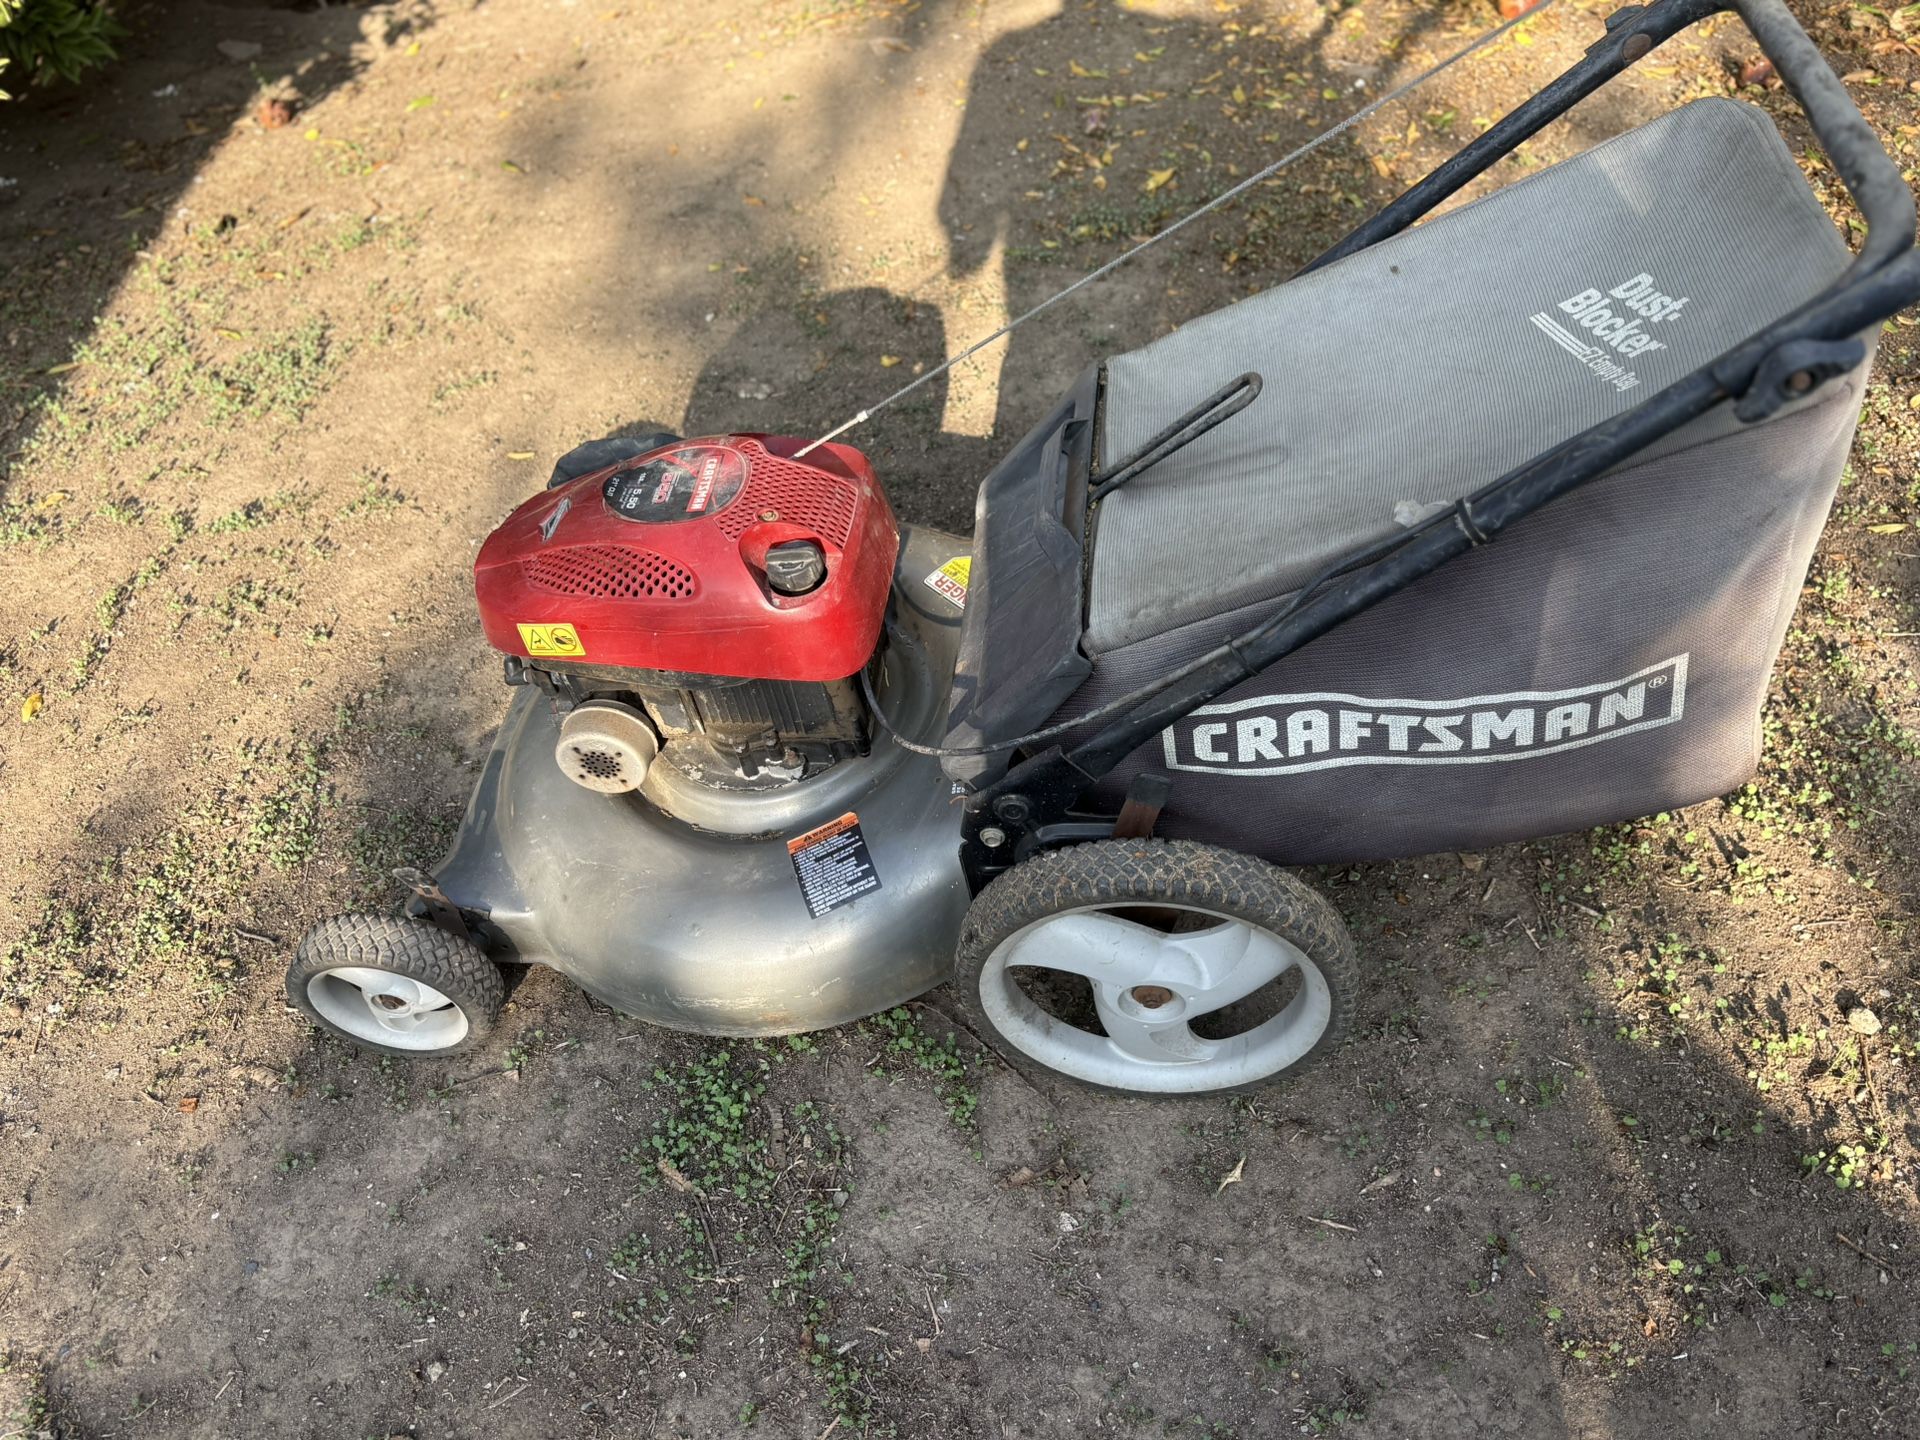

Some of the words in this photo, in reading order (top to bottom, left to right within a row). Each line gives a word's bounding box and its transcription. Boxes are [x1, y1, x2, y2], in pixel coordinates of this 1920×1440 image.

[1557, 287, 1662, 358] Blocker
[626, 488, 643, 509] 5.50
[691, 458, 718, 510] CRAFTSMAN
[935, 576, 966, 605] NGER
[812, 820, 842, 837] WARNING
